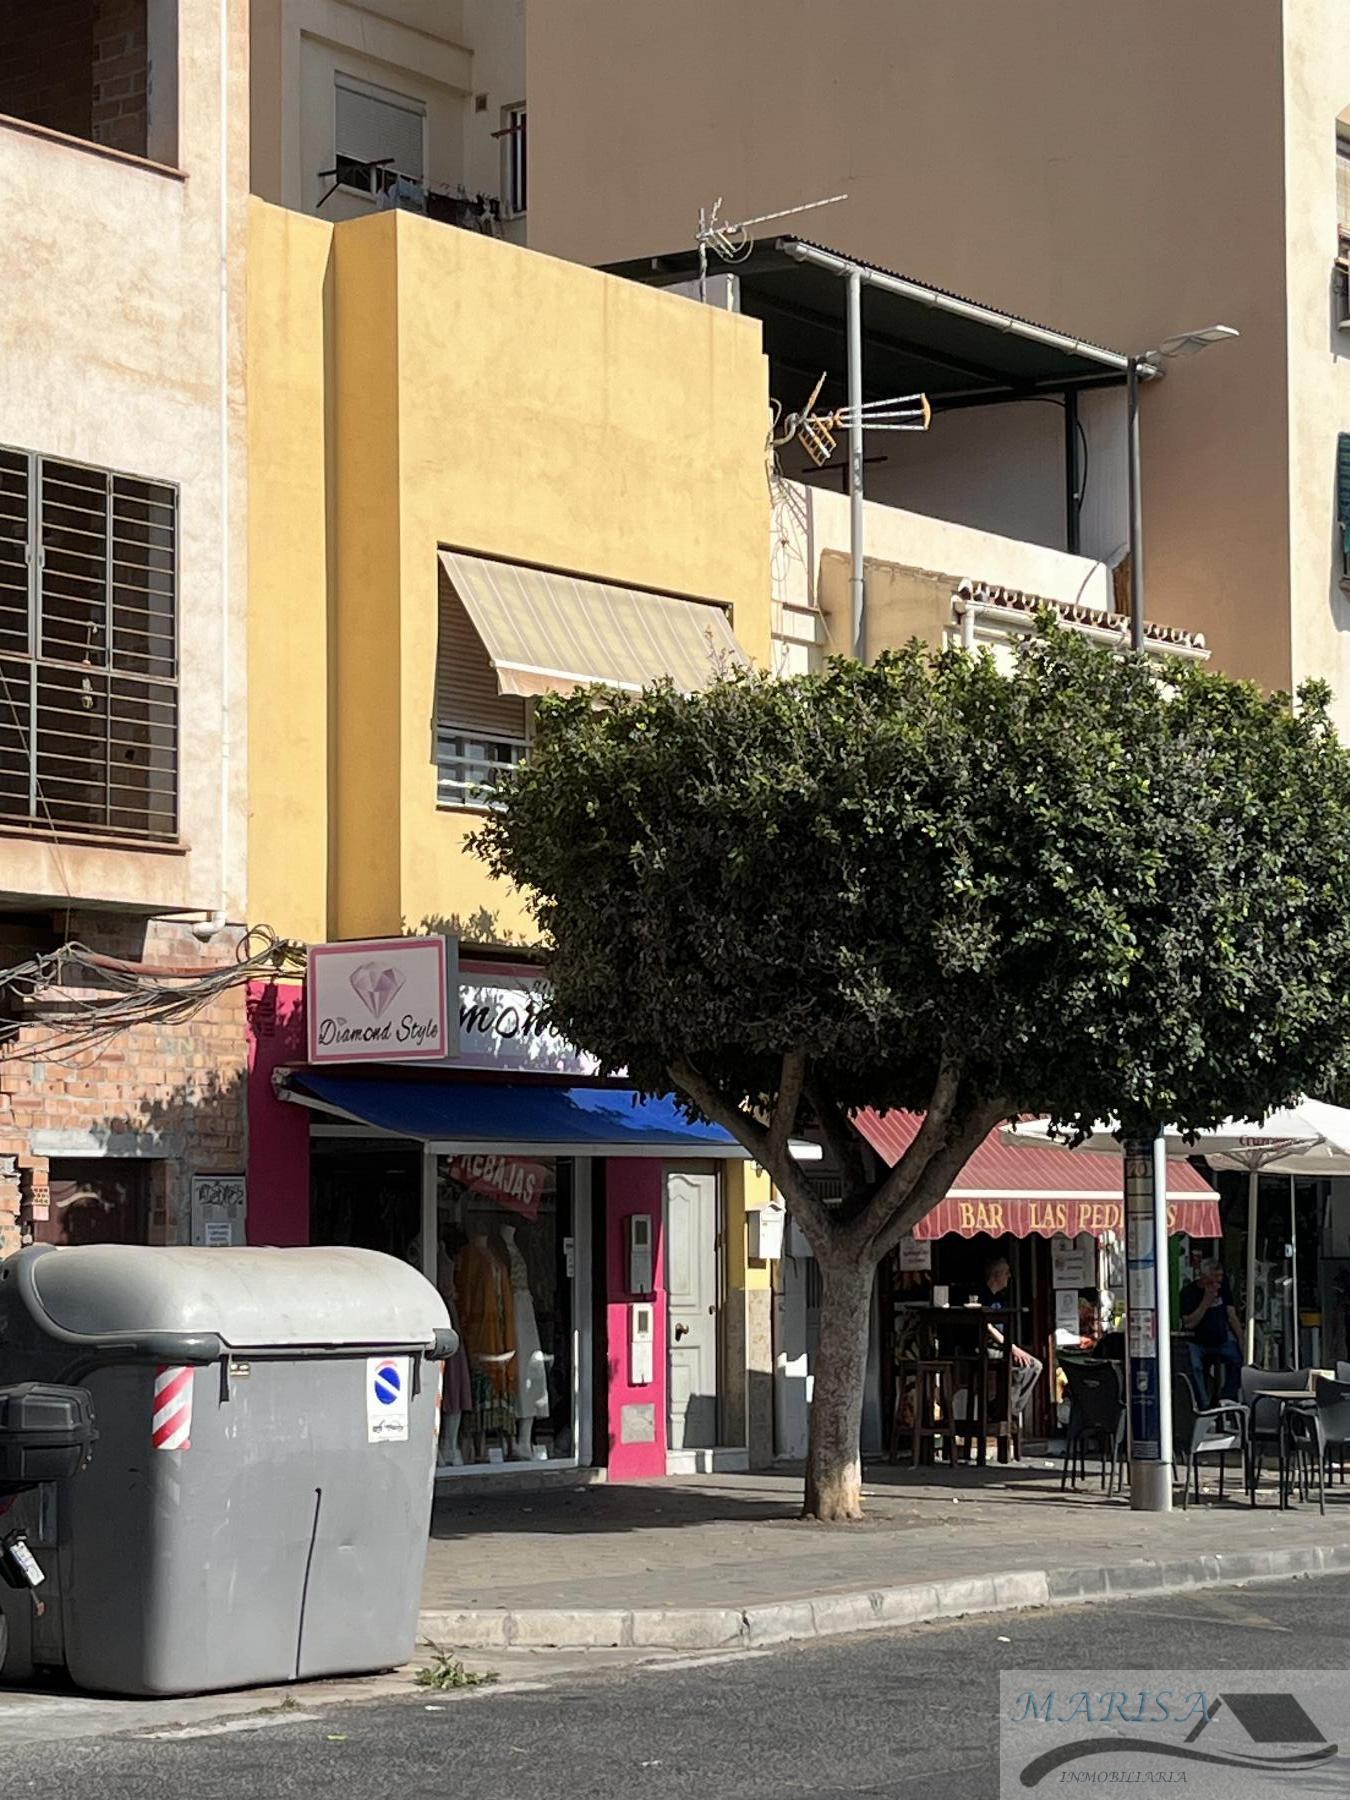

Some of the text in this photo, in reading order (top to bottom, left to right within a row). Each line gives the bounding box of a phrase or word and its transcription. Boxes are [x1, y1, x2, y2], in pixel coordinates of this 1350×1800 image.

[318, 1014, 438, 1046] Diamond Style
[960, 1202, 1004, 1229] BAR
[1029, 1203, 1066, 1229] LAS
